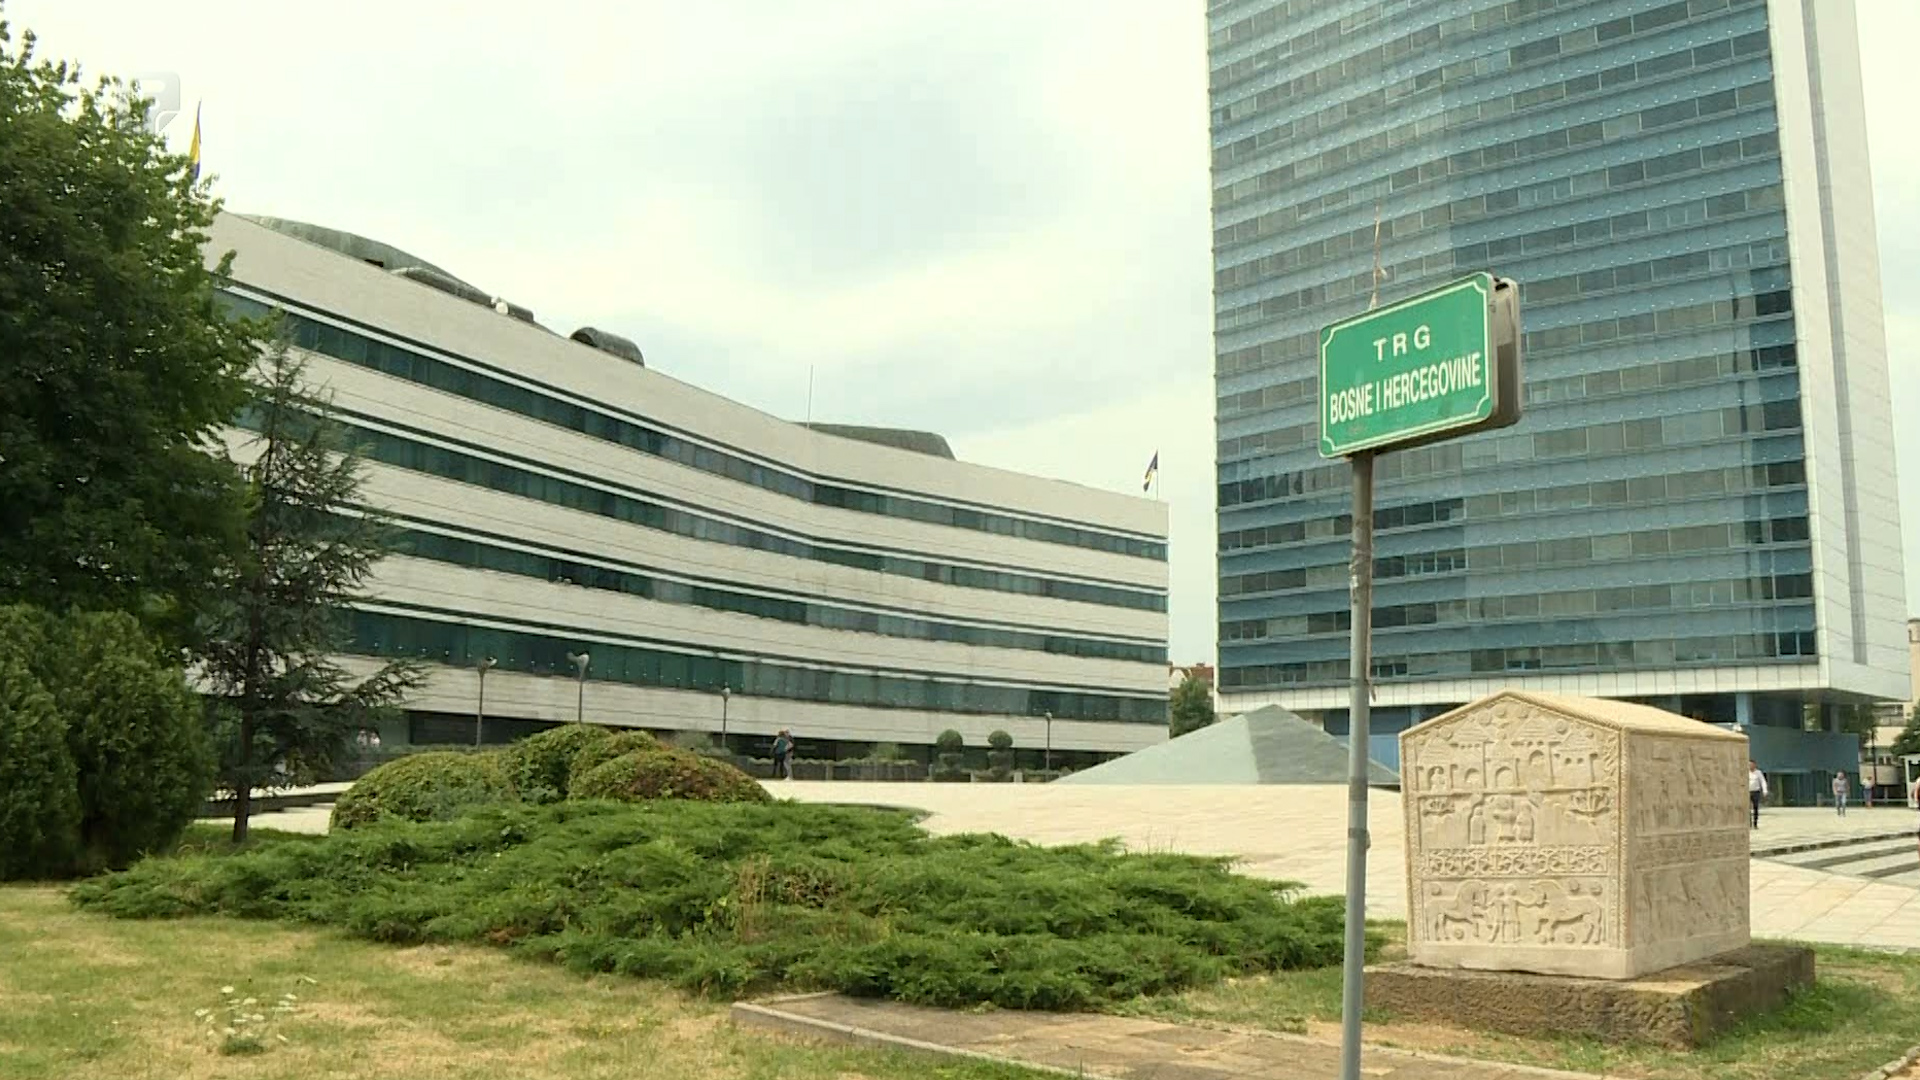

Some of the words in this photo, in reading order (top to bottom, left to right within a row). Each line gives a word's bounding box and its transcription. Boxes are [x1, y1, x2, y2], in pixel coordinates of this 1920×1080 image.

[1373, 325, 1430, 361] TRG
[1330, 383, 1373, 425] BOSNE
[1376, 381, 1380, 412] I
[1383, 352, 1481, 411] HERCEGOVINE
